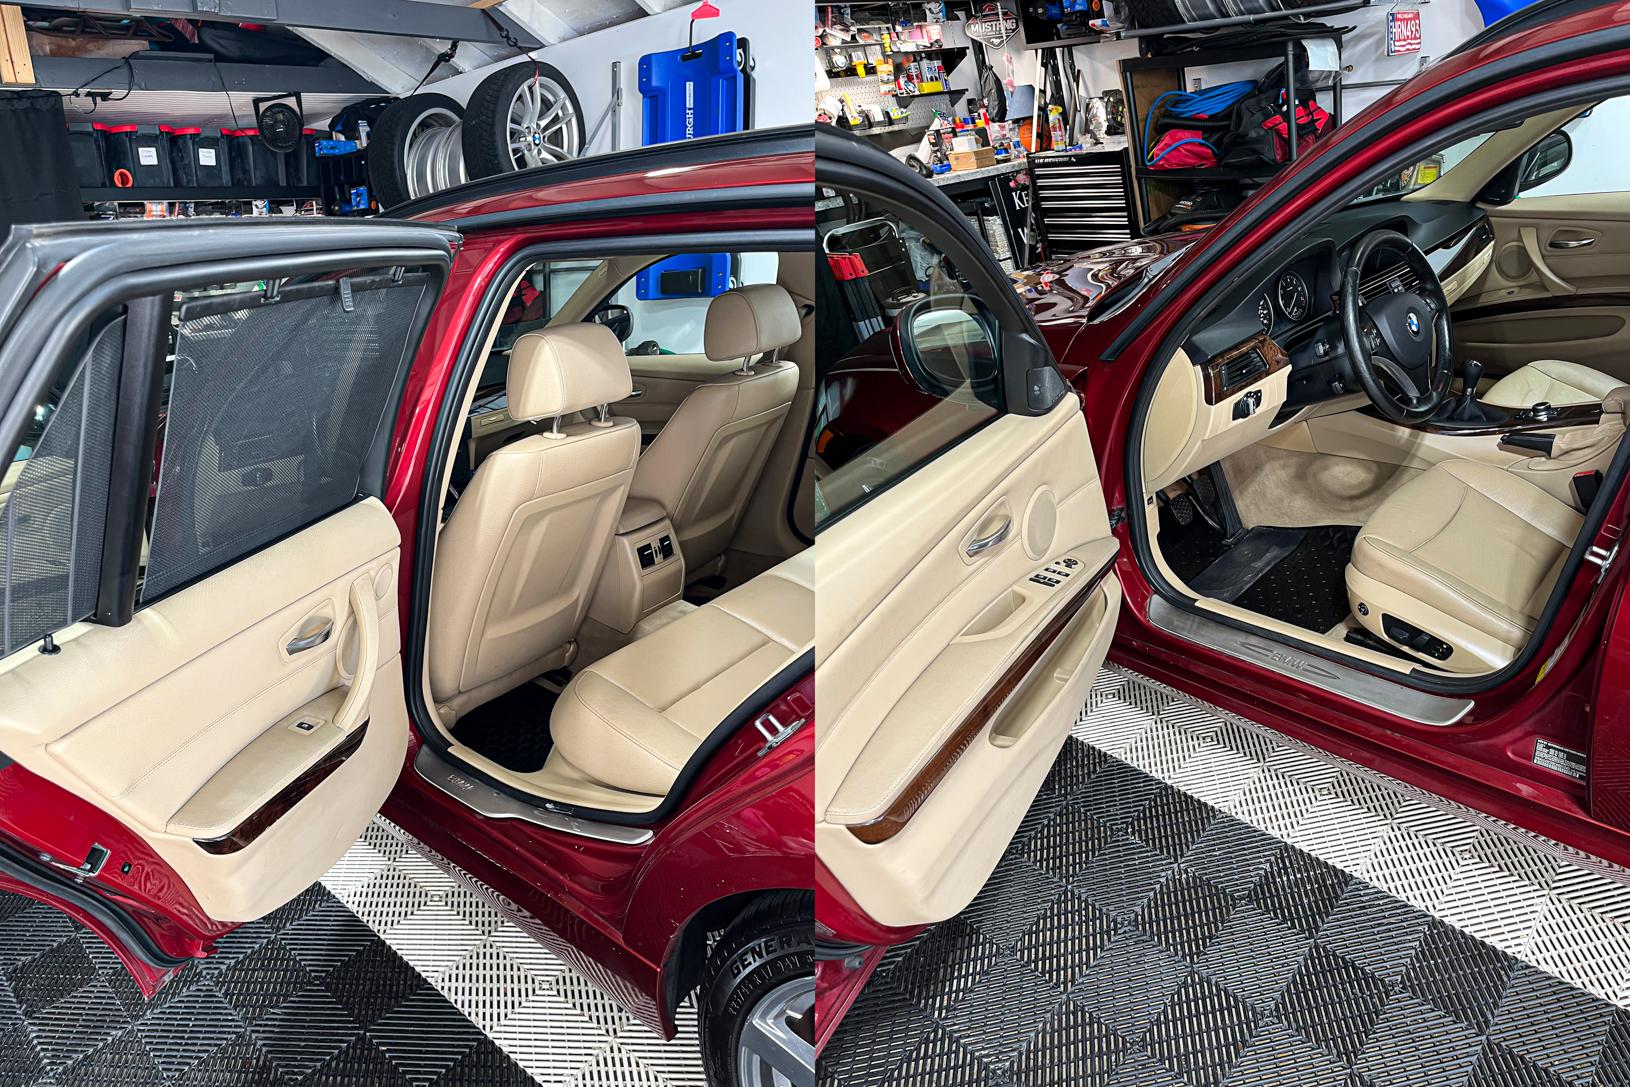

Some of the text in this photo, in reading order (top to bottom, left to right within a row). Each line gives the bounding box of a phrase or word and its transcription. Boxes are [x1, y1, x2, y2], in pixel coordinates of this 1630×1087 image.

[970, 19, 1017, 34] MUSTANG
[1392, 20, 1420, 40] HRN493
[1272, 651, 1308, 670] BMW
